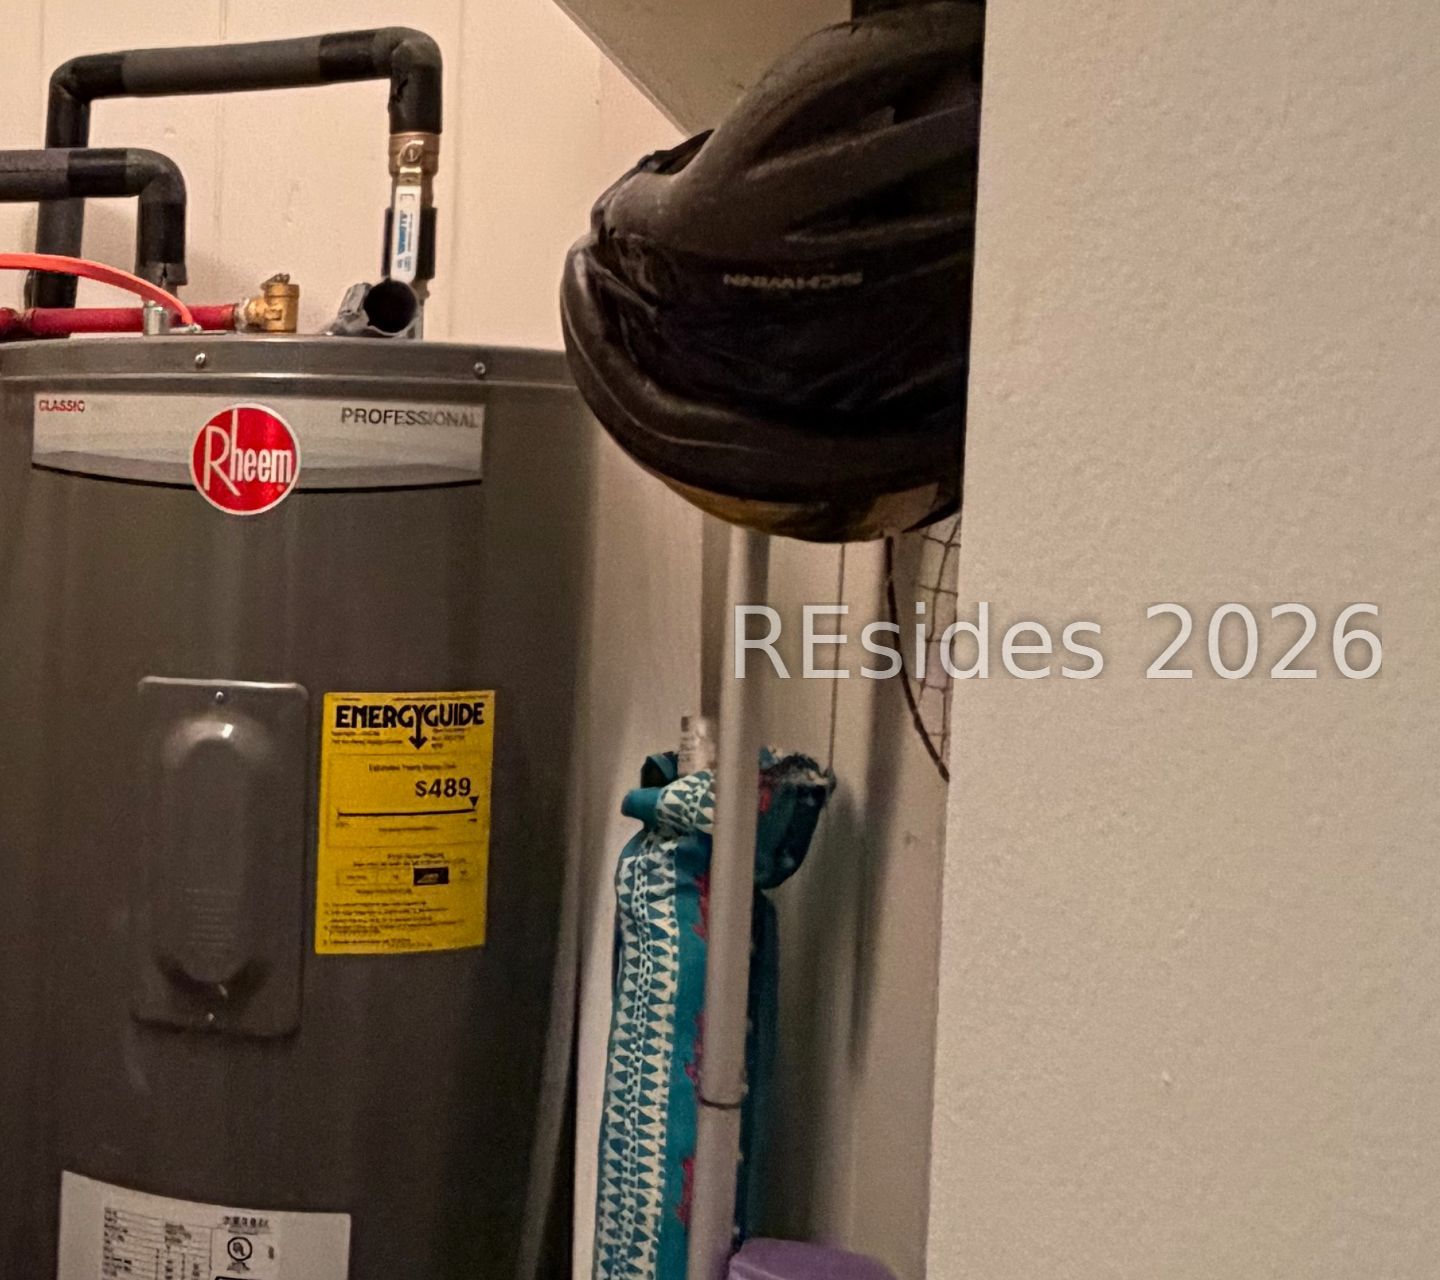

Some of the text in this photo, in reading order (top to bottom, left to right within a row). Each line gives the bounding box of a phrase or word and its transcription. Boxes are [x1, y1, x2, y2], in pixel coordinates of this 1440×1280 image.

[340, 406, 479, 429] PROFESSIONAL
[204, 409, 292, 496] Rheem
[334, 702, 486, 732] ENERGYGUIDE
[415, 777, 472, 798] $489
